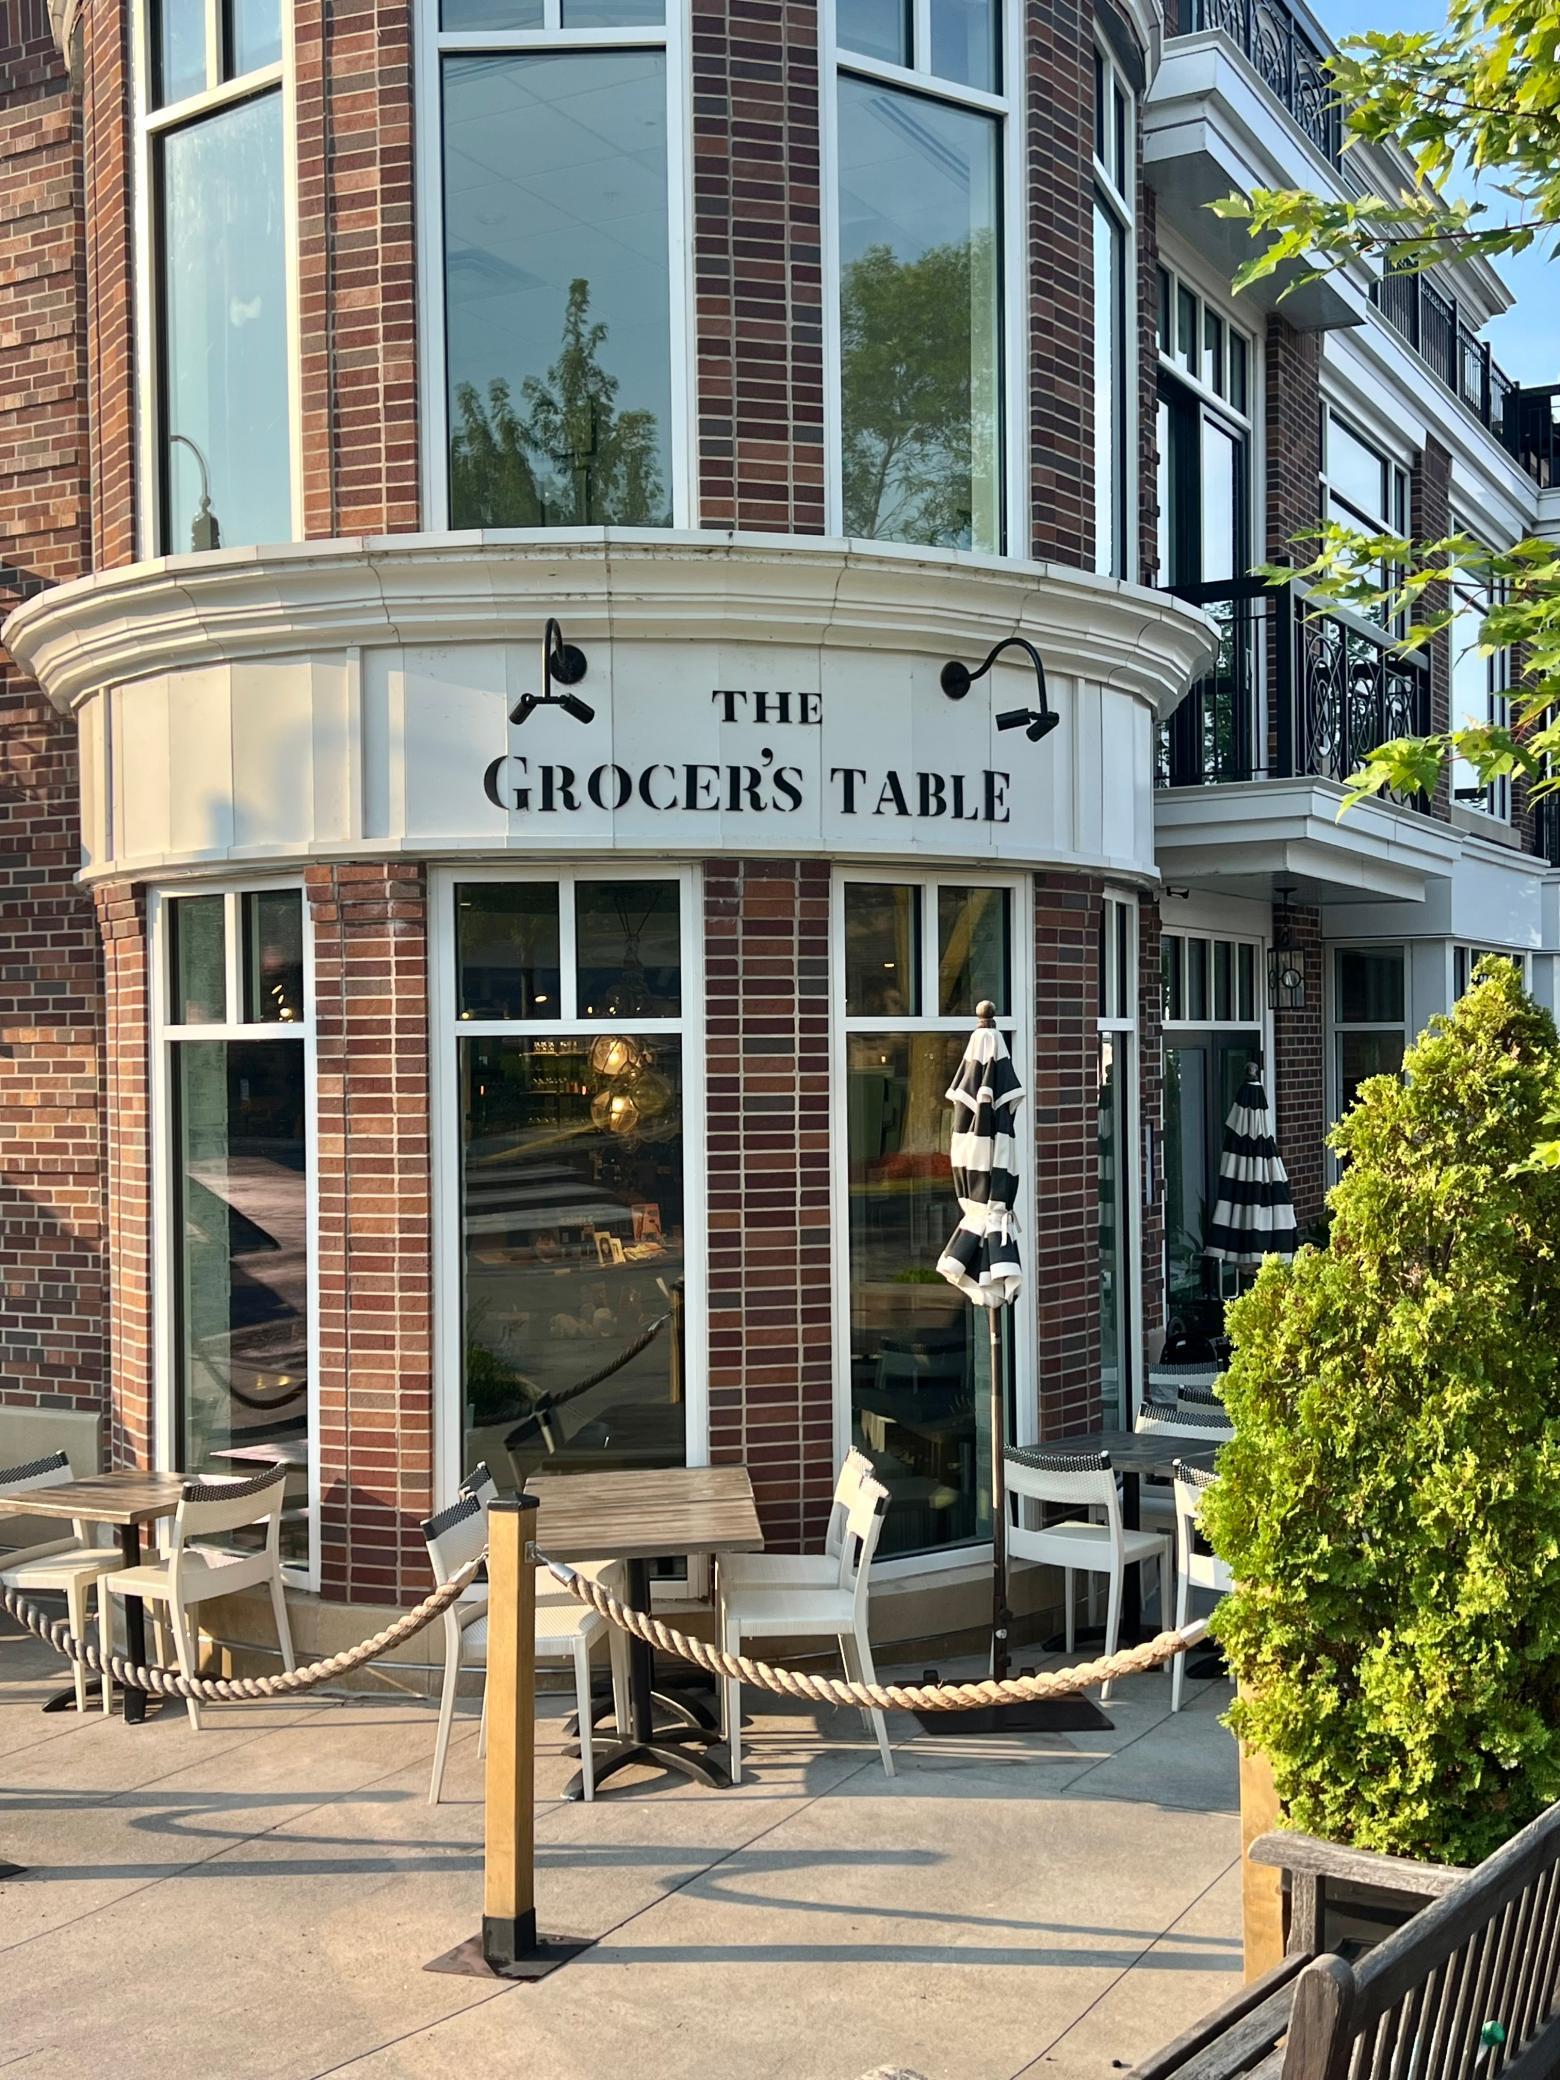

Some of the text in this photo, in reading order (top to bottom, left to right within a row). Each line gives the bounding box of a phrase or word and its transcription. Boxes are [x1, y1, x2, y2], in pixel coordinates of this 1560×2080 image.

[711, 690, 822, 725] THE
[483, 747, 1011, 823] GROCER’S TABLE
